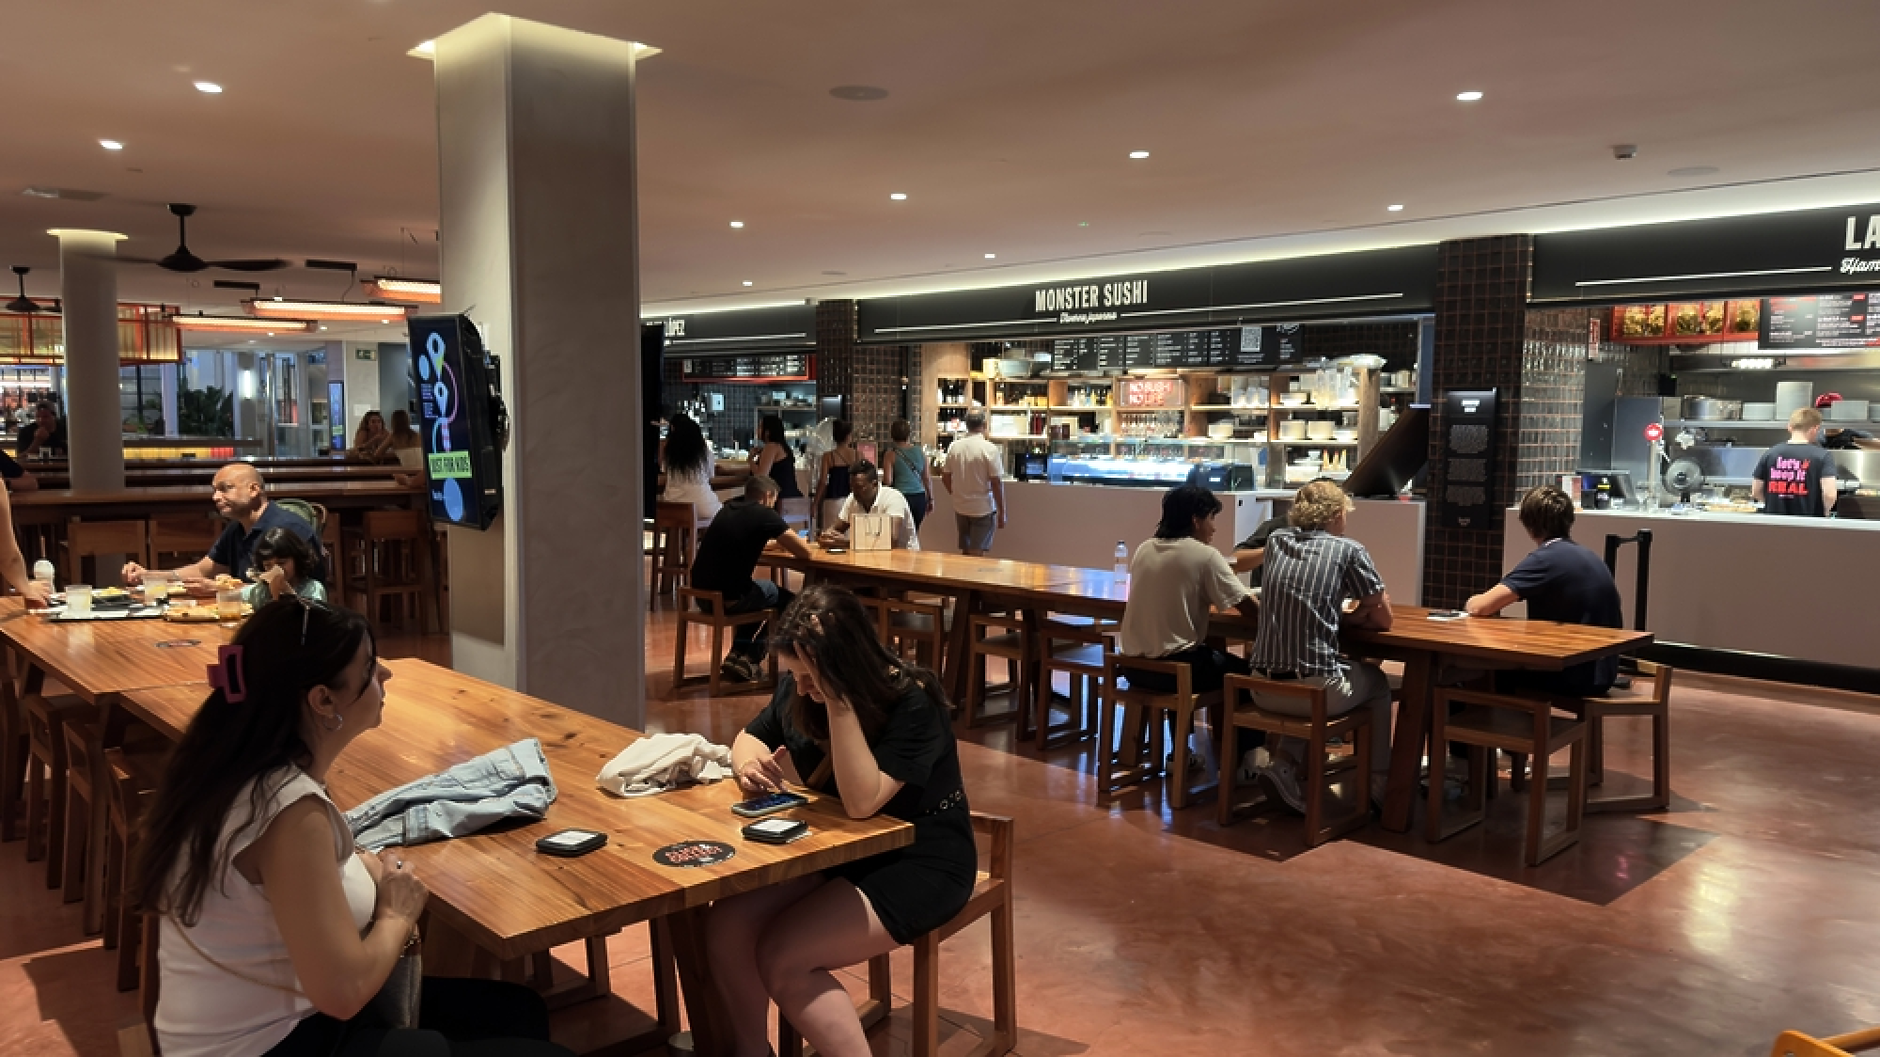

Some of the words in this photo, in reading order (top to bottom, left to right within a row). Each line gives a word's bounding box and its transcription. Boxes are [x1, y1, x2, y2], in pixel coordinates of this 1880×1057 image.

[1844, 215, 1880, 250] LA
[1035, 285, 1099, 312] MONSTER
[1103, 280, 1148, 307] SUSHI
[1768, 481, 1808, 495] REAL
